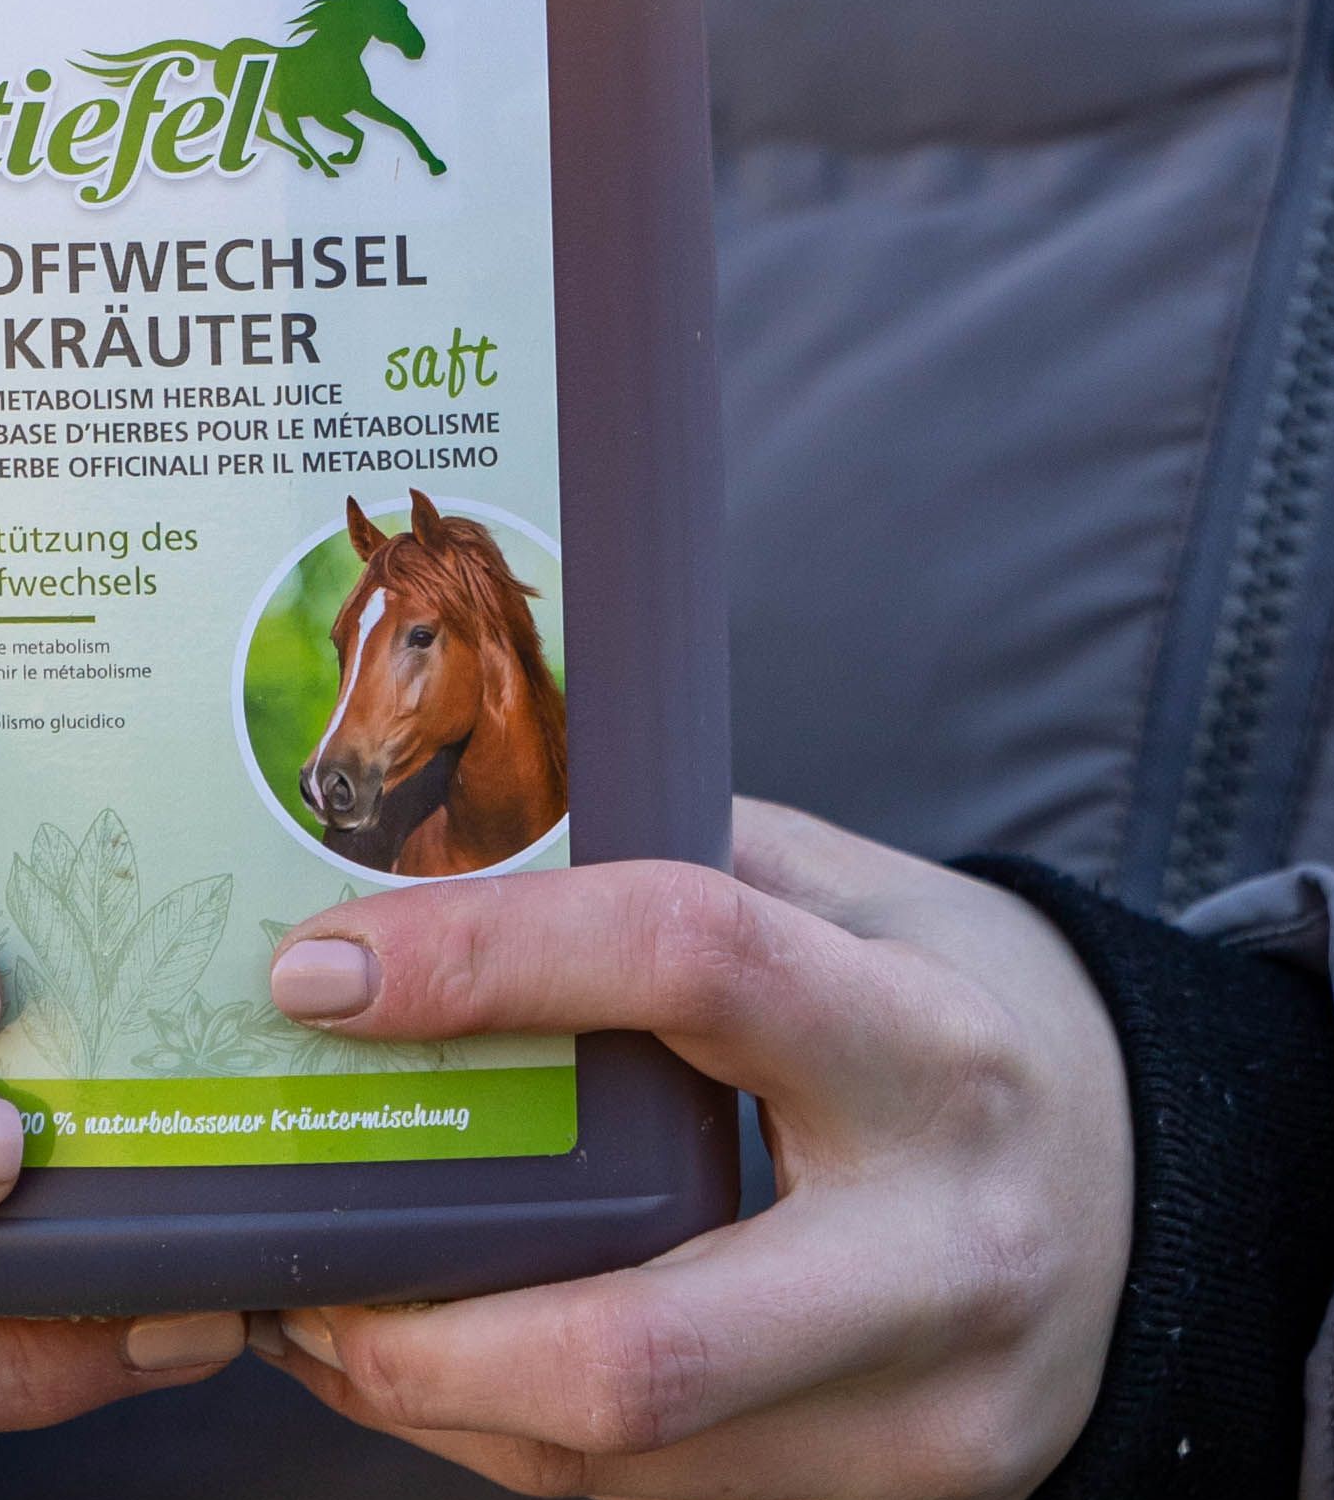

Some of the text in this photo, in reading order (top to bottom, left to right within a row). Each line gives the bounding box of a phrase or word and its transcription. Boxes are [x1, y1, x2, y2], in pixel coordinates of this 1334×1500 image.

[3, 303, 499, 399] KRÄUTER saft
[163, 385, 266, 409] HERBAL
[272, 383, 343, 407] JUICE
[197, 419, 269, 442] POUR
[277, 418, 305, 441] LE
[313, 411, 500, 440] MÉTABOLISME
[68, 454, 209, 478] OFFICINALI
[217, 453, 265, 476] PER
[272, 452, 294, 475] IL
[302, 446, 499, 474] METABOLISMO
[141, 521, 199, 553] des
[12, 637, 111, 655] metabolism
[23, 662, 38, 681] le
[42, 662, 153, 680] métabolisme
[49, 712, 126, 734] glucidico
[19, 1103, 471, 1136] 00 % naturbelassener Kräutermischung
